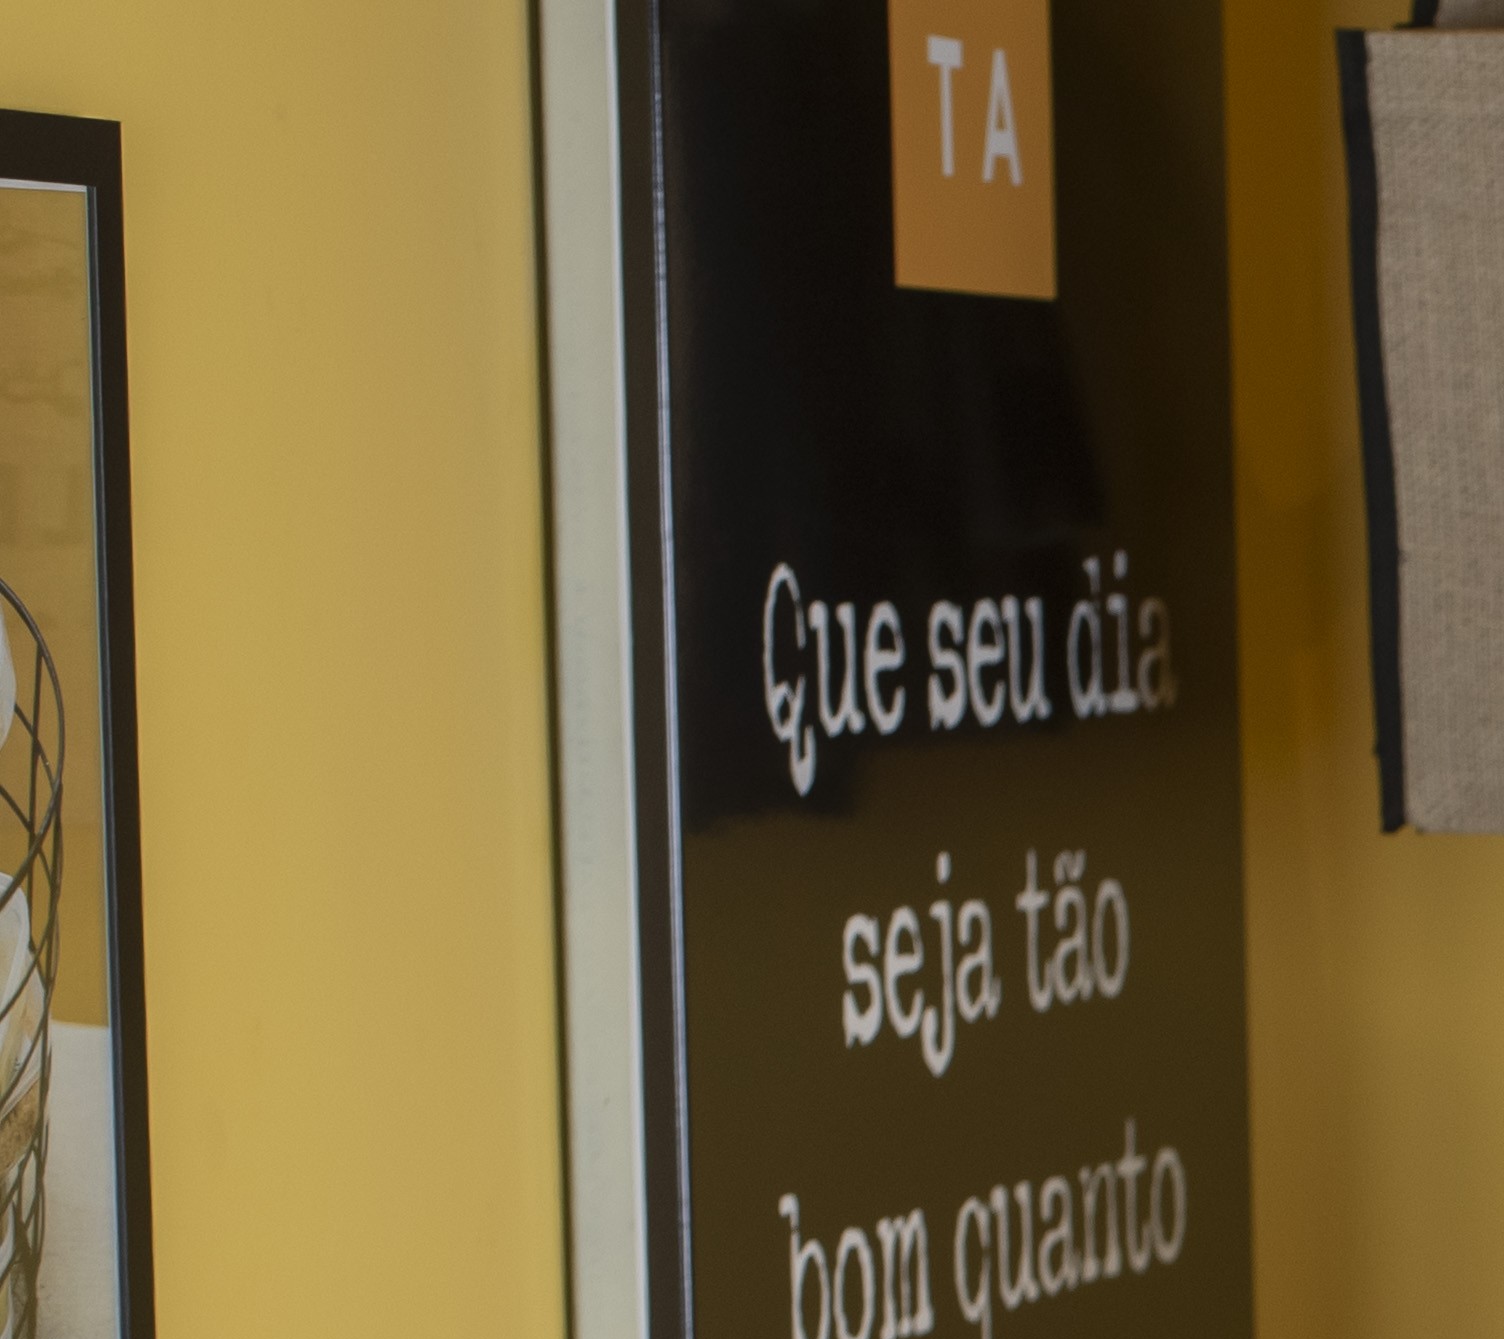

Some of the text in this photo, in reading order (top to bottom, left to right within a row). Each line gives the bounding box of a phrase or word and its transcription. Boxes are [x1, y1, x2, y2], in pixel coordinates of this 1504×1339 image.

[762, 550, 1181, 797] Que seu dia
[841, 849, 1130, 1078] seja tão
